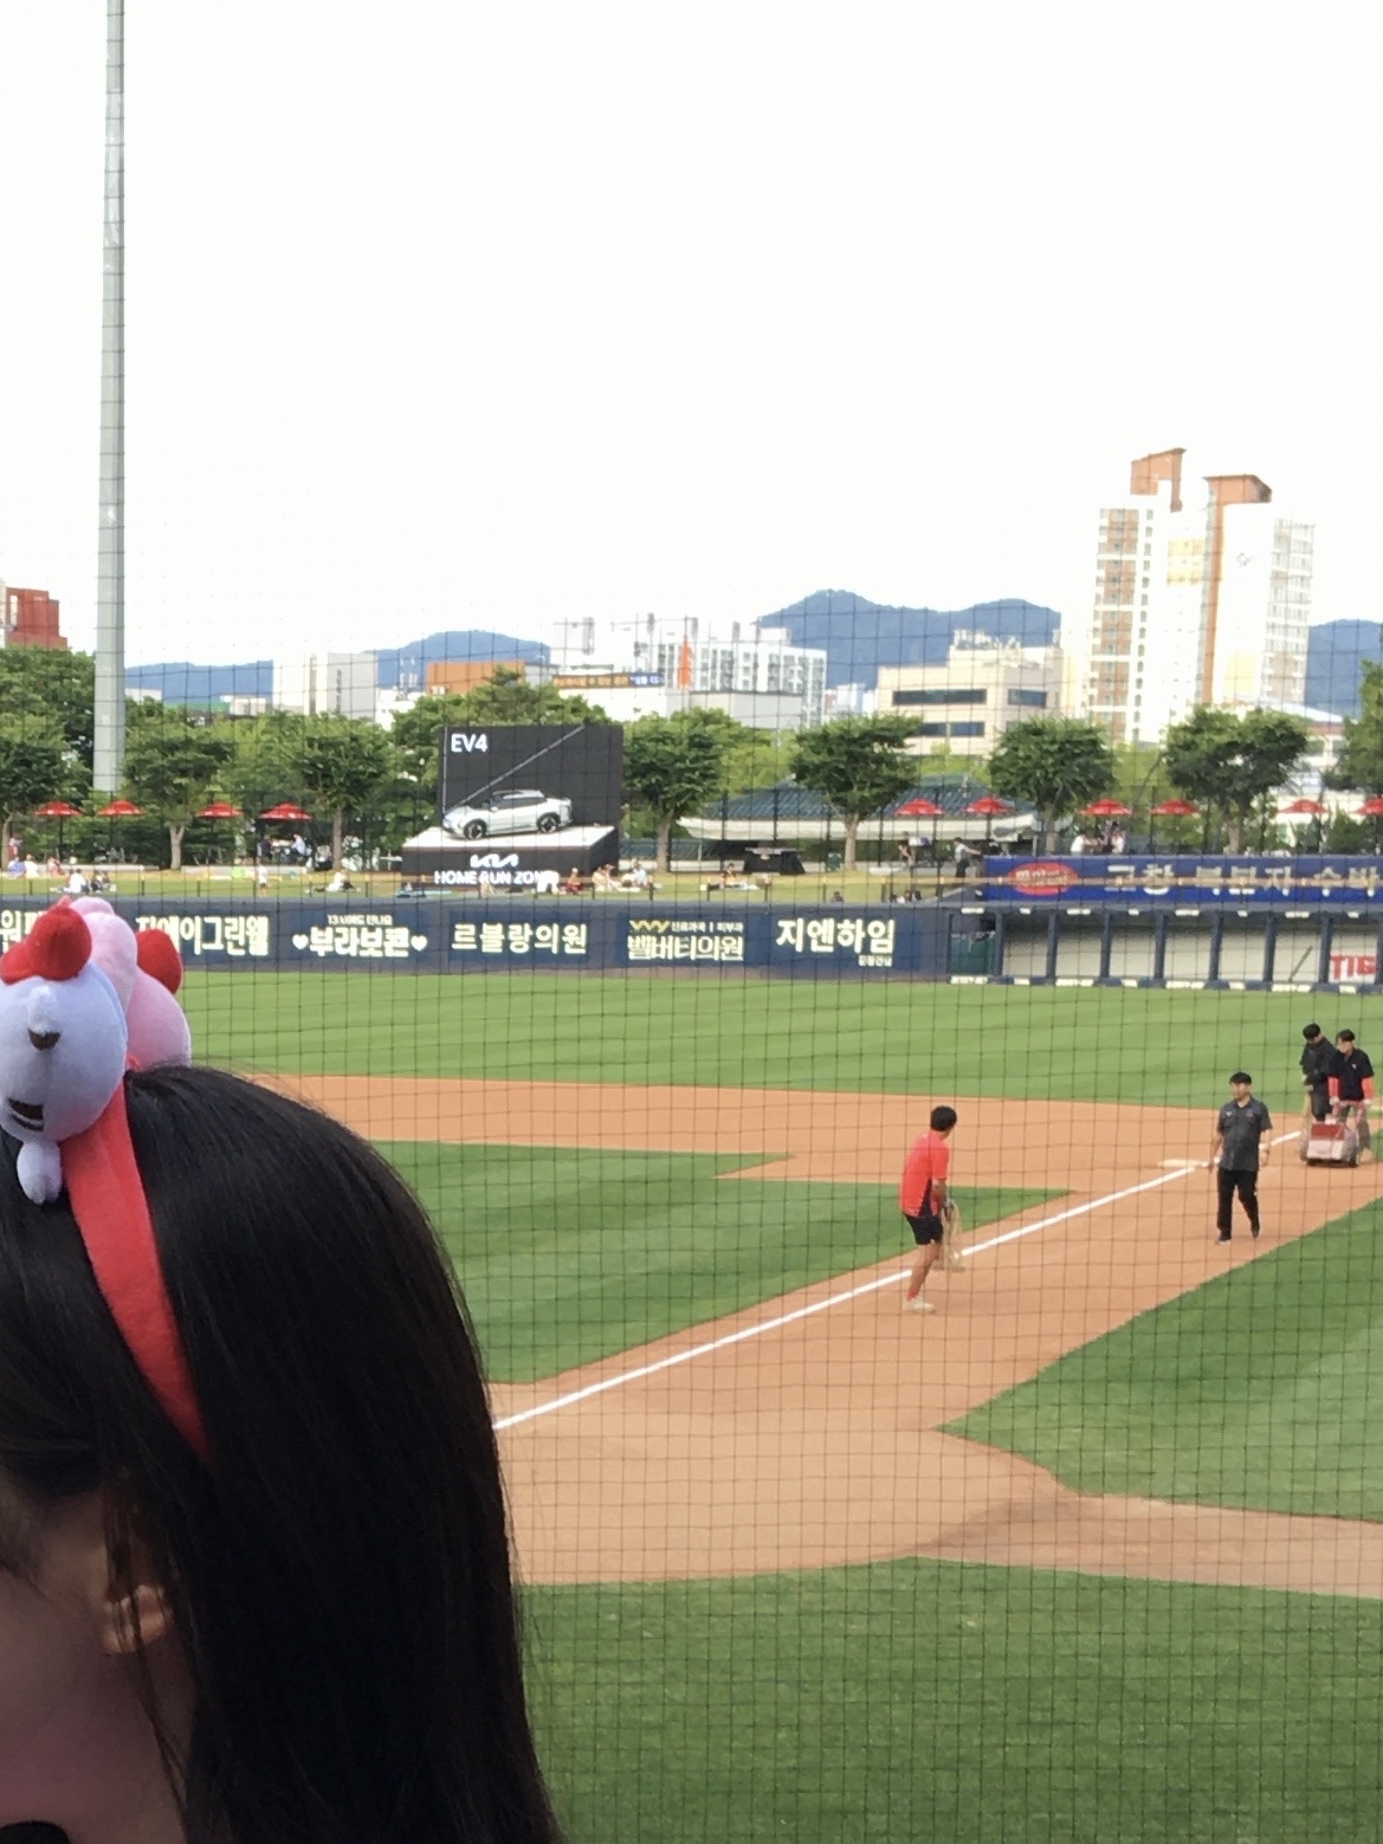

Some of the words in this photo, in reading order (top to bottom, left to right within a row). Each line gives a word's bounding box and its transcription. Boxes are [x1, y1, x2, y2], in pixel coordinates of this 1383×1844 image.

[451, 734, 488, 752] EV4
[434, 871, 477, 885] HOME
[479, 871, 513, 885] RUN
[515, 871, 549, 885] ZON
[309, 926, 410, 957] 부라보콘
[451, 923, 587, 954] 르블랑의원
[776, 918, 895, 953] 지엔하임
